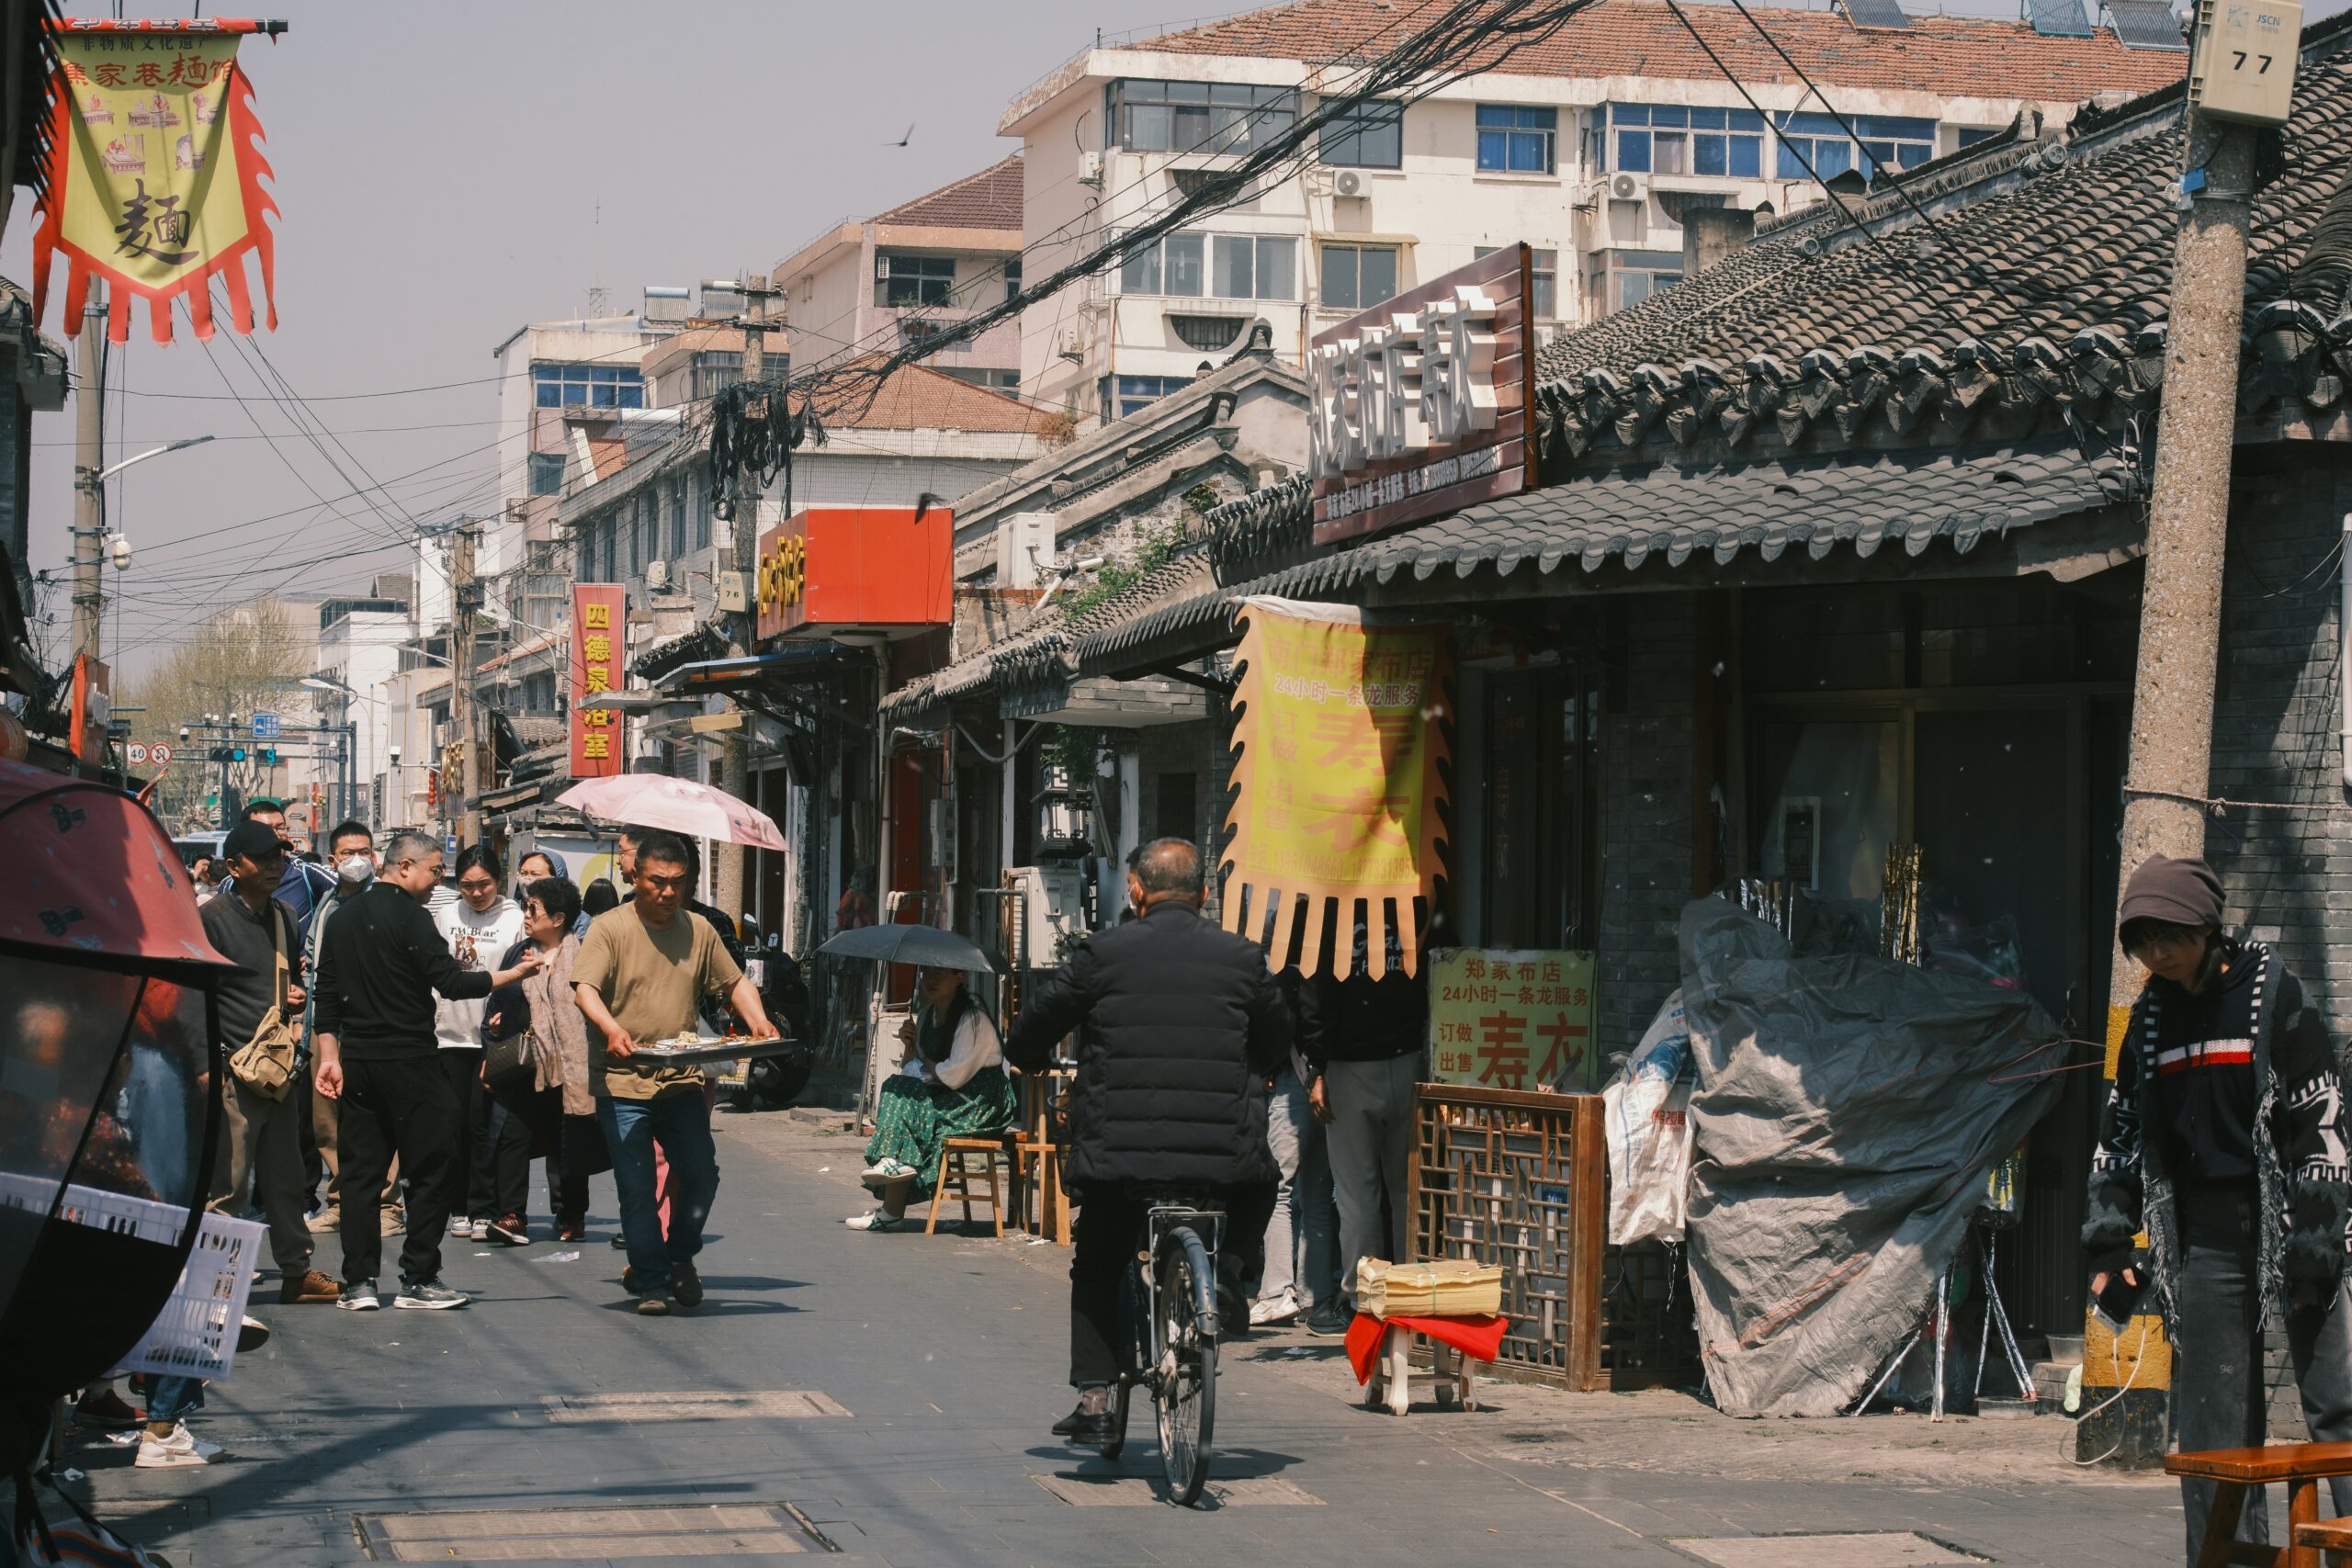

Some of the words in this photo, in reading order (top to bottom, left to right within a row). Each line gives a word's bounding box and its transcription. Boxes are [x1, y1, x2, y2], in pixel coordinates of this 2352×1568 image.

[2256, 14, 2280, 27] JSCN
[81, 34, 212, 51] 非物质文化遗产
[2233, 51, 2272, 74] 77
[1274, 673, 1420, 707] 24小时一条龙服务
[131, 749, 145, 759] 40
[1465, 957, 1562, 983] 郑家布店
[1442, 984, 1589, 1006] 24小时一条龙服务
[1439, 1022, 1473, 1043] 订做
[1477, 1010, 1589, 1091] 寿衣
[1440, 1052, 1473, 1073] 出售
